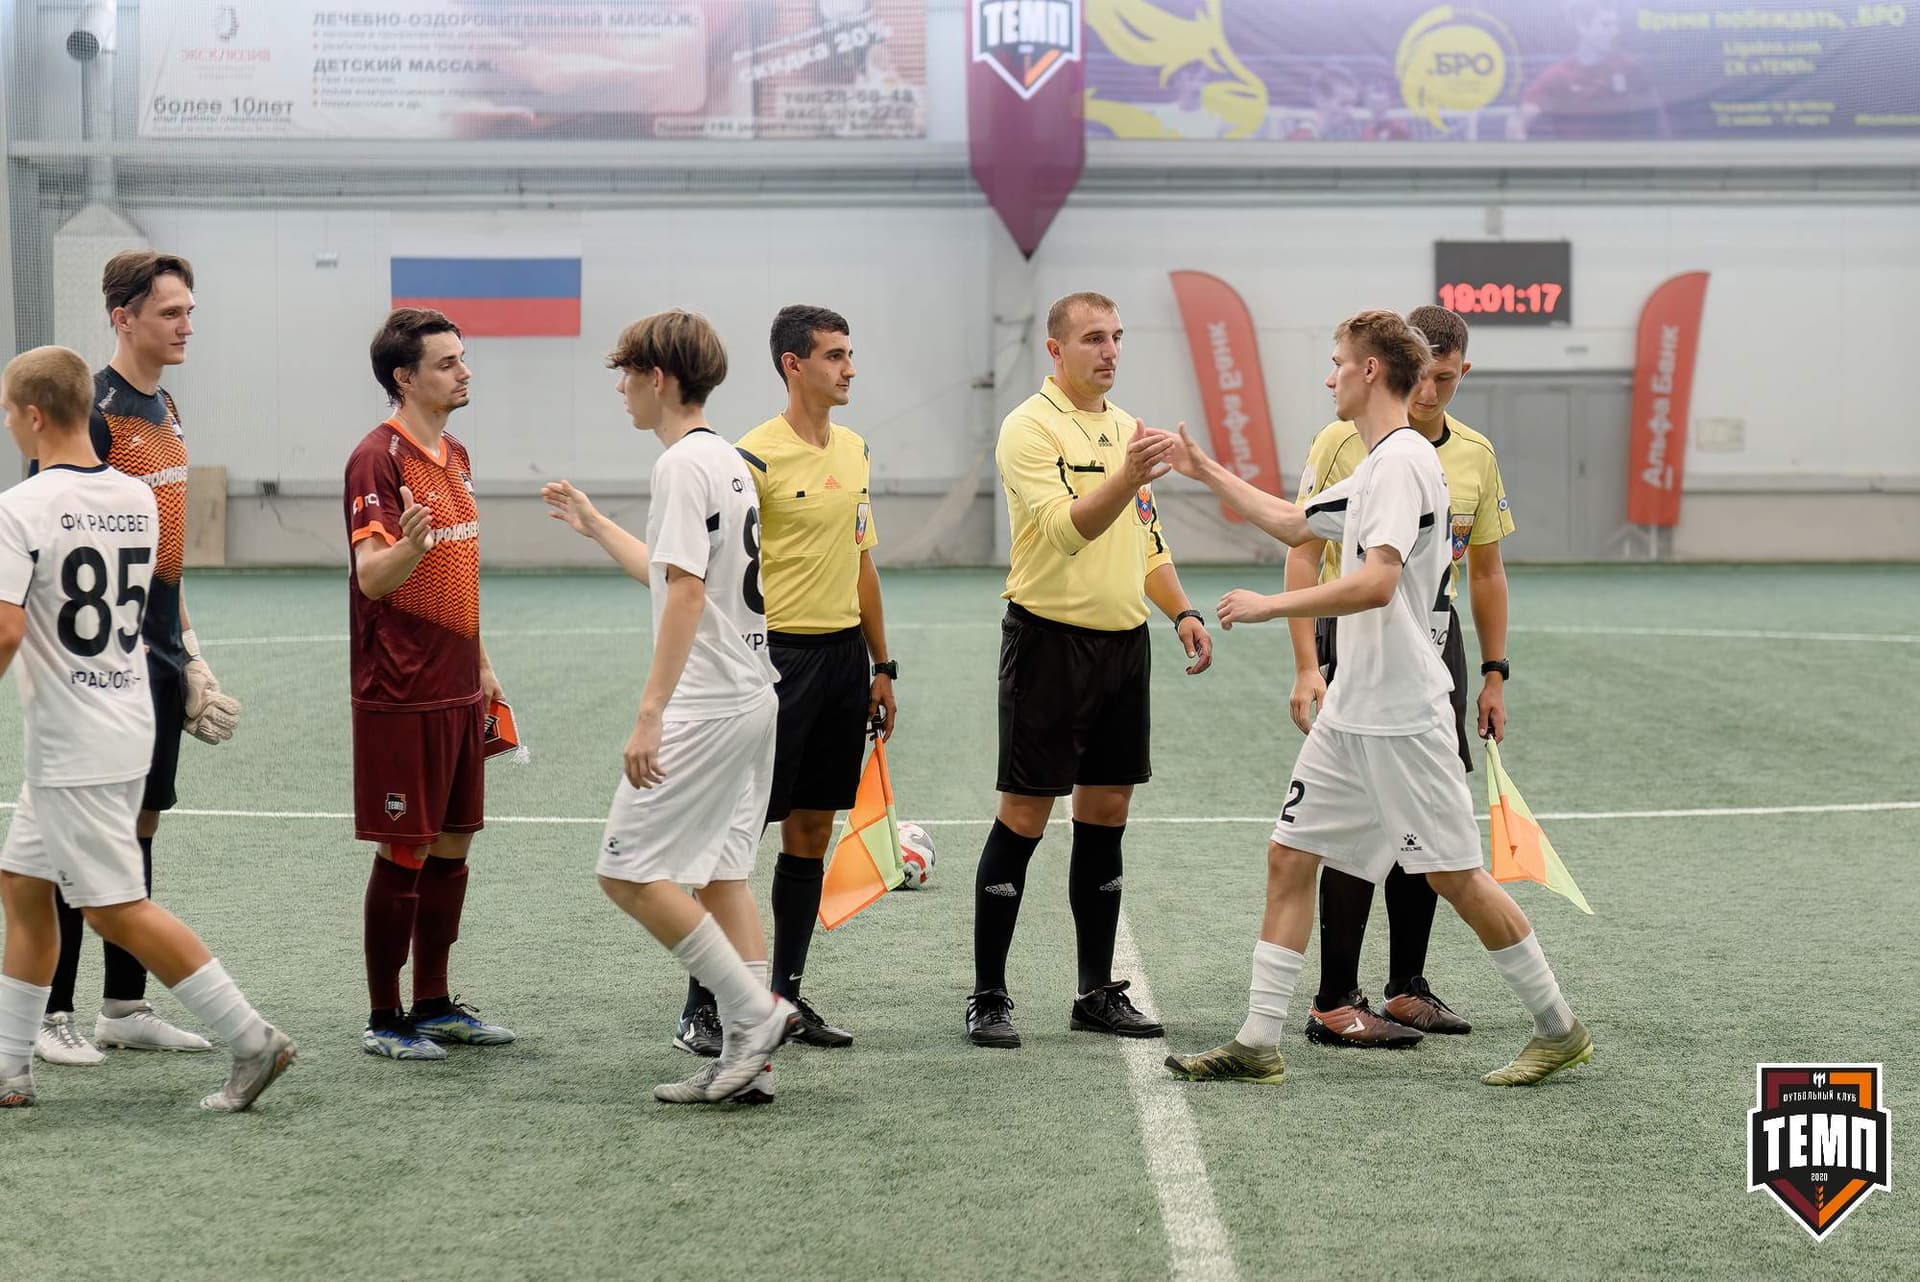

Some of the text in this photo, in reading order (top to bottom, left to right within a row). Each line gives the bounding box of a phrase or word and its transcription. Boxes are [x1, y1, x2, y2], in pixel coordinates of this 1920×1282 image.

[834, 22, 893, 54] 20%
[982, 0, 1070, 47] ТЕМП
[313, 57, 401, 74] ДЕТСКИЙ
[153, 95, 294, 116] более 10лет
[1641, 324, 1681, 490] Альфа Банк
[61, 513, 149, 532] ФК РАССВЕТ
[57, 546, 152, 657] 85
[1281, 780, 1305, 823] 2
